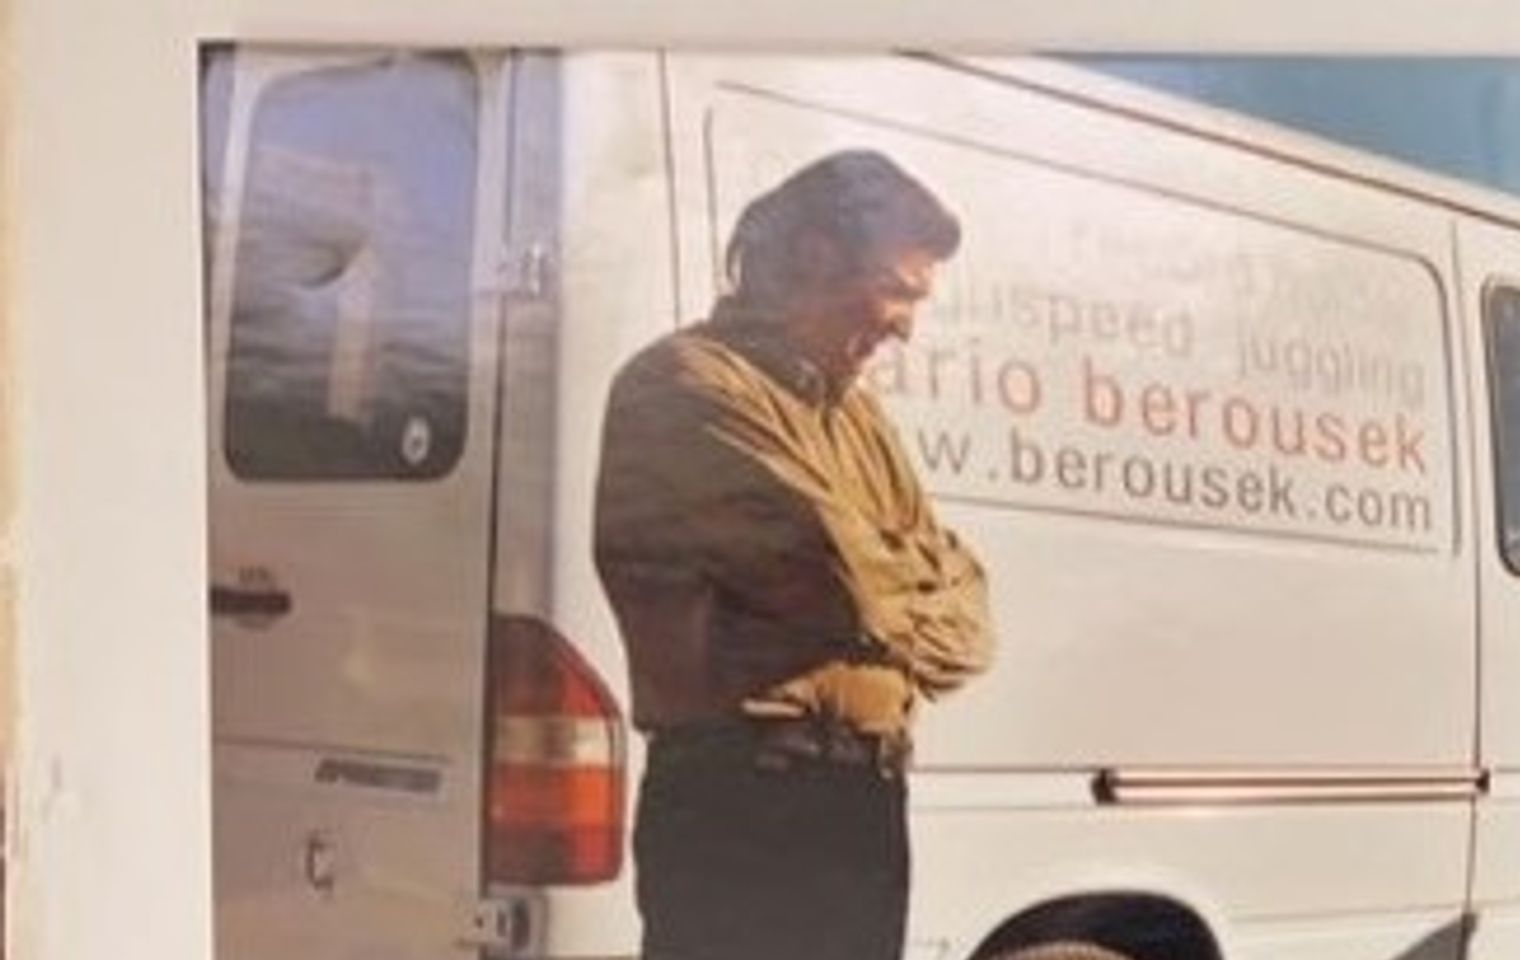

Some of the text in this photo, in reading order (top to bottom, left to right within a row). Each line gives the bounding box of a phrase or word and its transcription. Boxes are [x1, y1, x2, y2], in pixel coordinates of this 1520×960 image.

[870, 335, 1428, 476] ario berousek
[917, 423, 1434, 534] w.berousek.com
